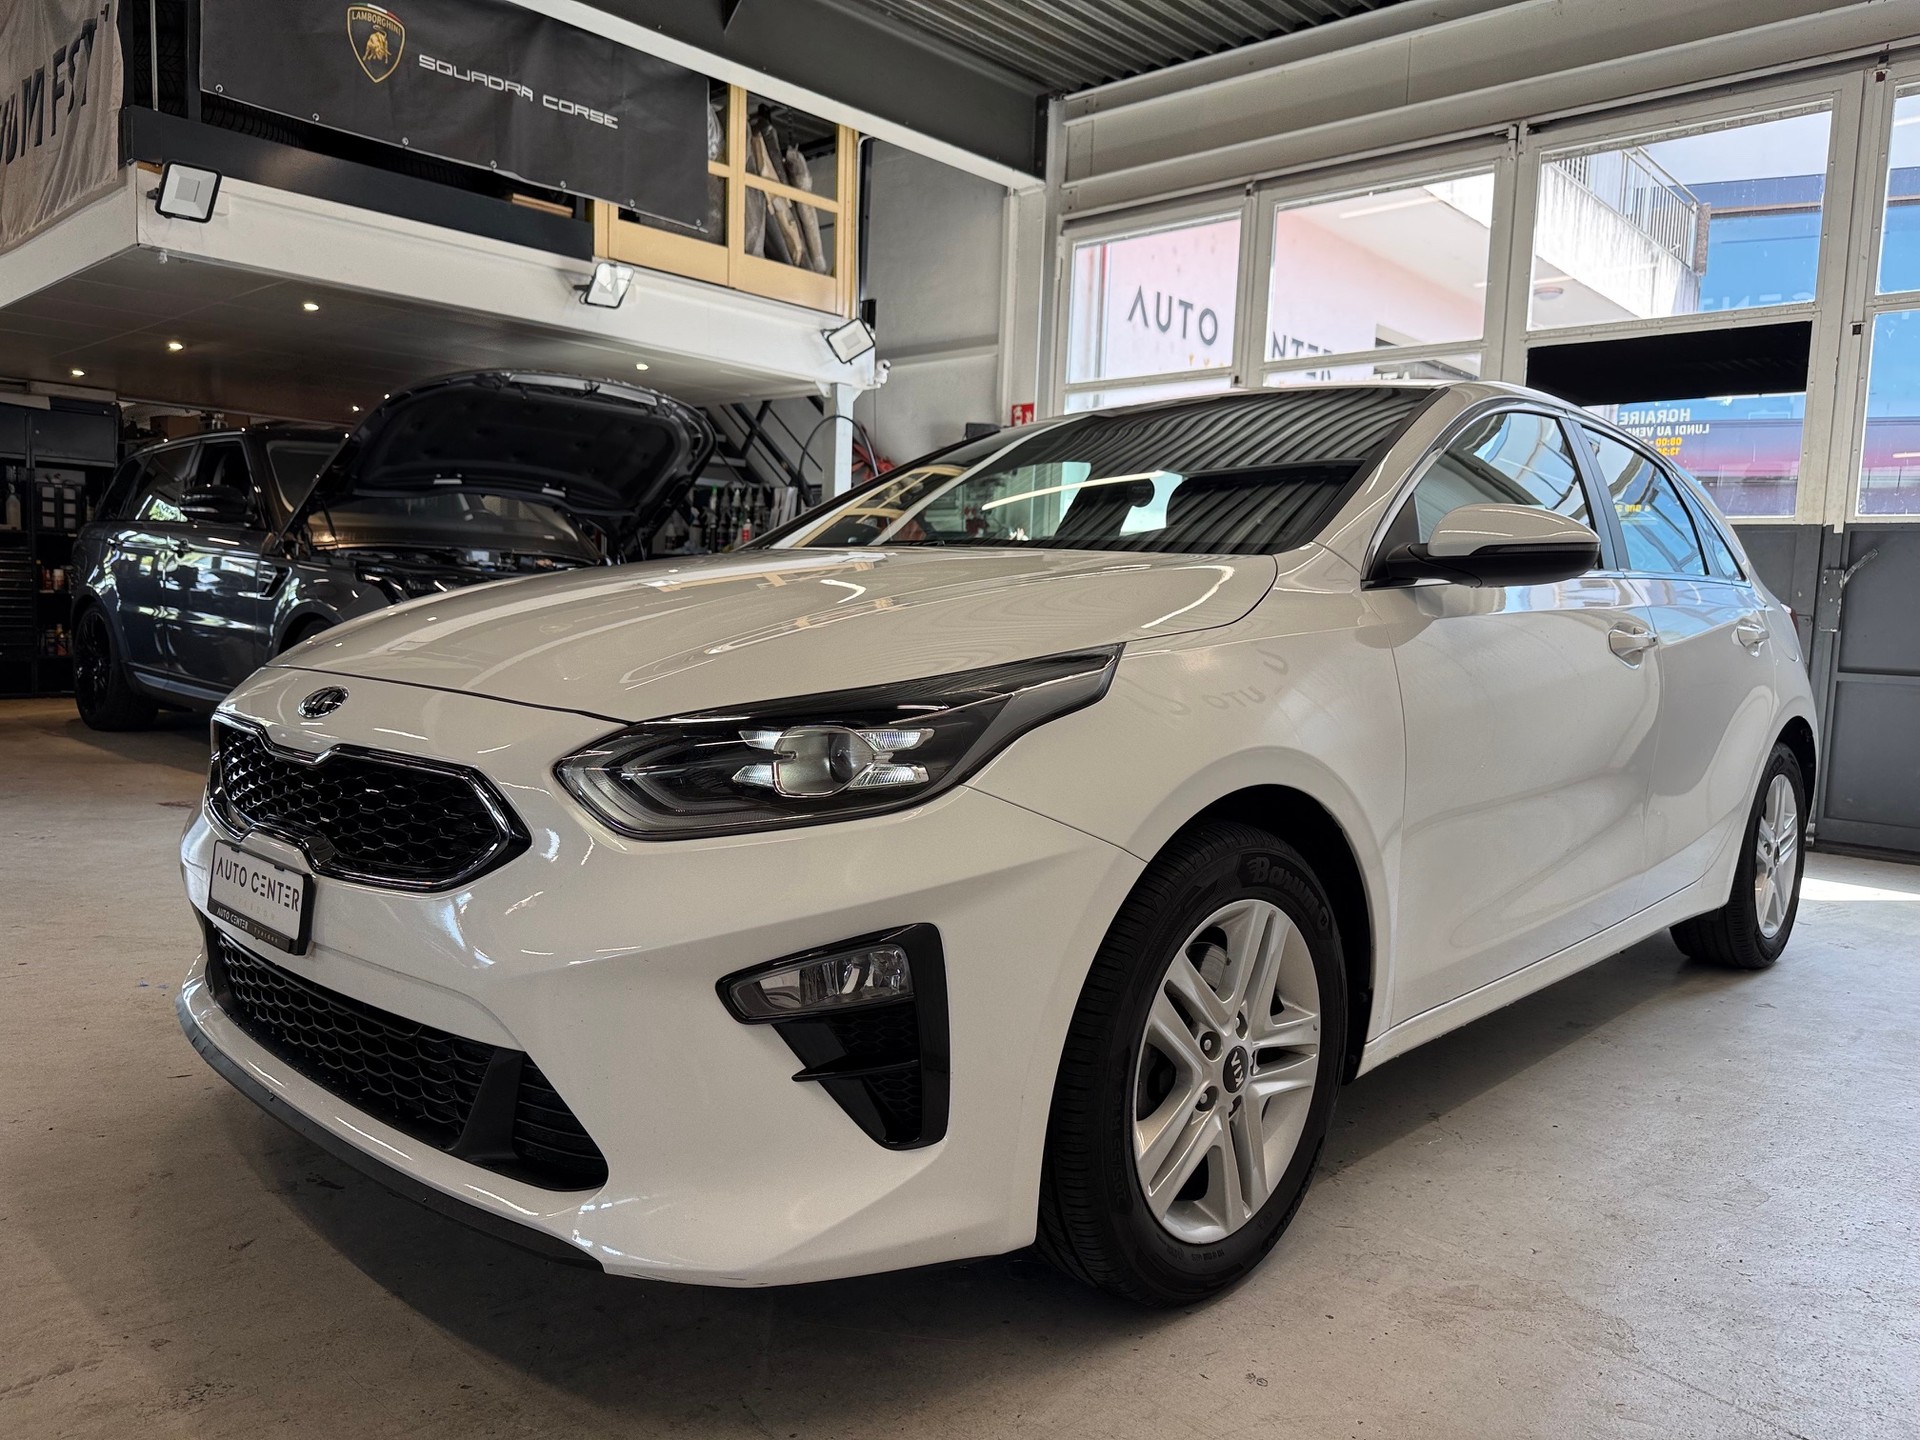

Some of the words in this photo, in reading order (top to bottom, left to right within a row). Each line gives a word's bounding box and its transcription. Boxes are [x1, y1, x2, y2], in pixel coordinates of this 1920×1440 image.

[351, 11, 401, 36] LAMBORGHINI
[419, 54, 534, 102] SQUADRA
[543, 95, 619, 130] CORSE
[1127, 285, 1219, 346] AUTO
[216, 857, 247, 887] AUTO
[251, 871, 300, 912] CENTER
[217, 908, 230, 920] AUTO
[231, 913, 249, 929] CENTER
[1230, 1051, 1244, 1088] KIA
